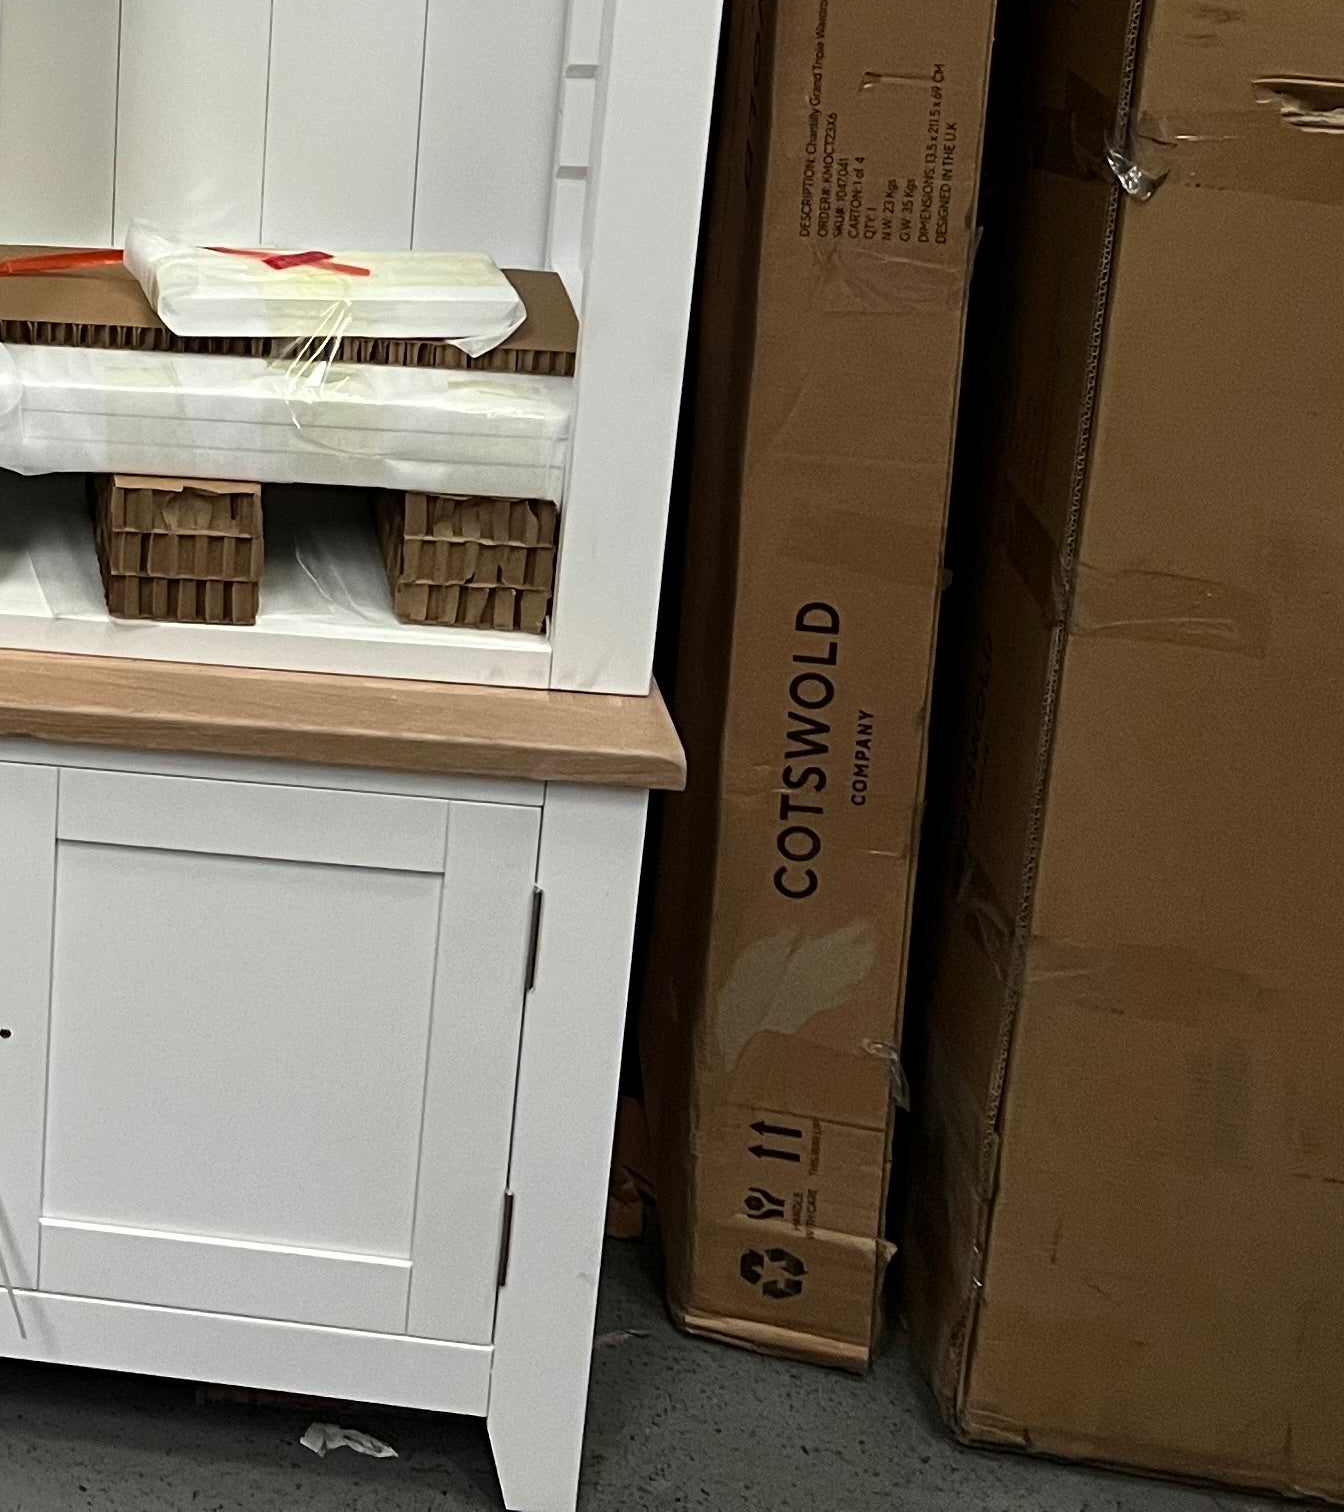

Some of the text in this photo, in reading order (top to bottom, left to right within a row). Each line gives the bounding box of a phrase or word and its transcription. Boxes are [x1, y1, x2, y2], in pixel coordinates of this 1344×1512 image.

[811, 40, 825, 70] Triple
[808, 71, 823, 106] Grand
[805, 107, 822, 155] Chantilly
[854, 156, 864, 164] 4
[942, 143, 955, 167] THE
[941, 167, 952, 181] IN
[884, 178, 898, 198] Kgs
[903, 176, 917, 198] Kgs
[883, 199, 894, 213] 23
[901, 199, 913, 213] 35
[934, 182, 951, 244] DESIGNED
[772, 600, 841, 900] COTSWOLD
[850, 709, 876, 807] COMPANY
